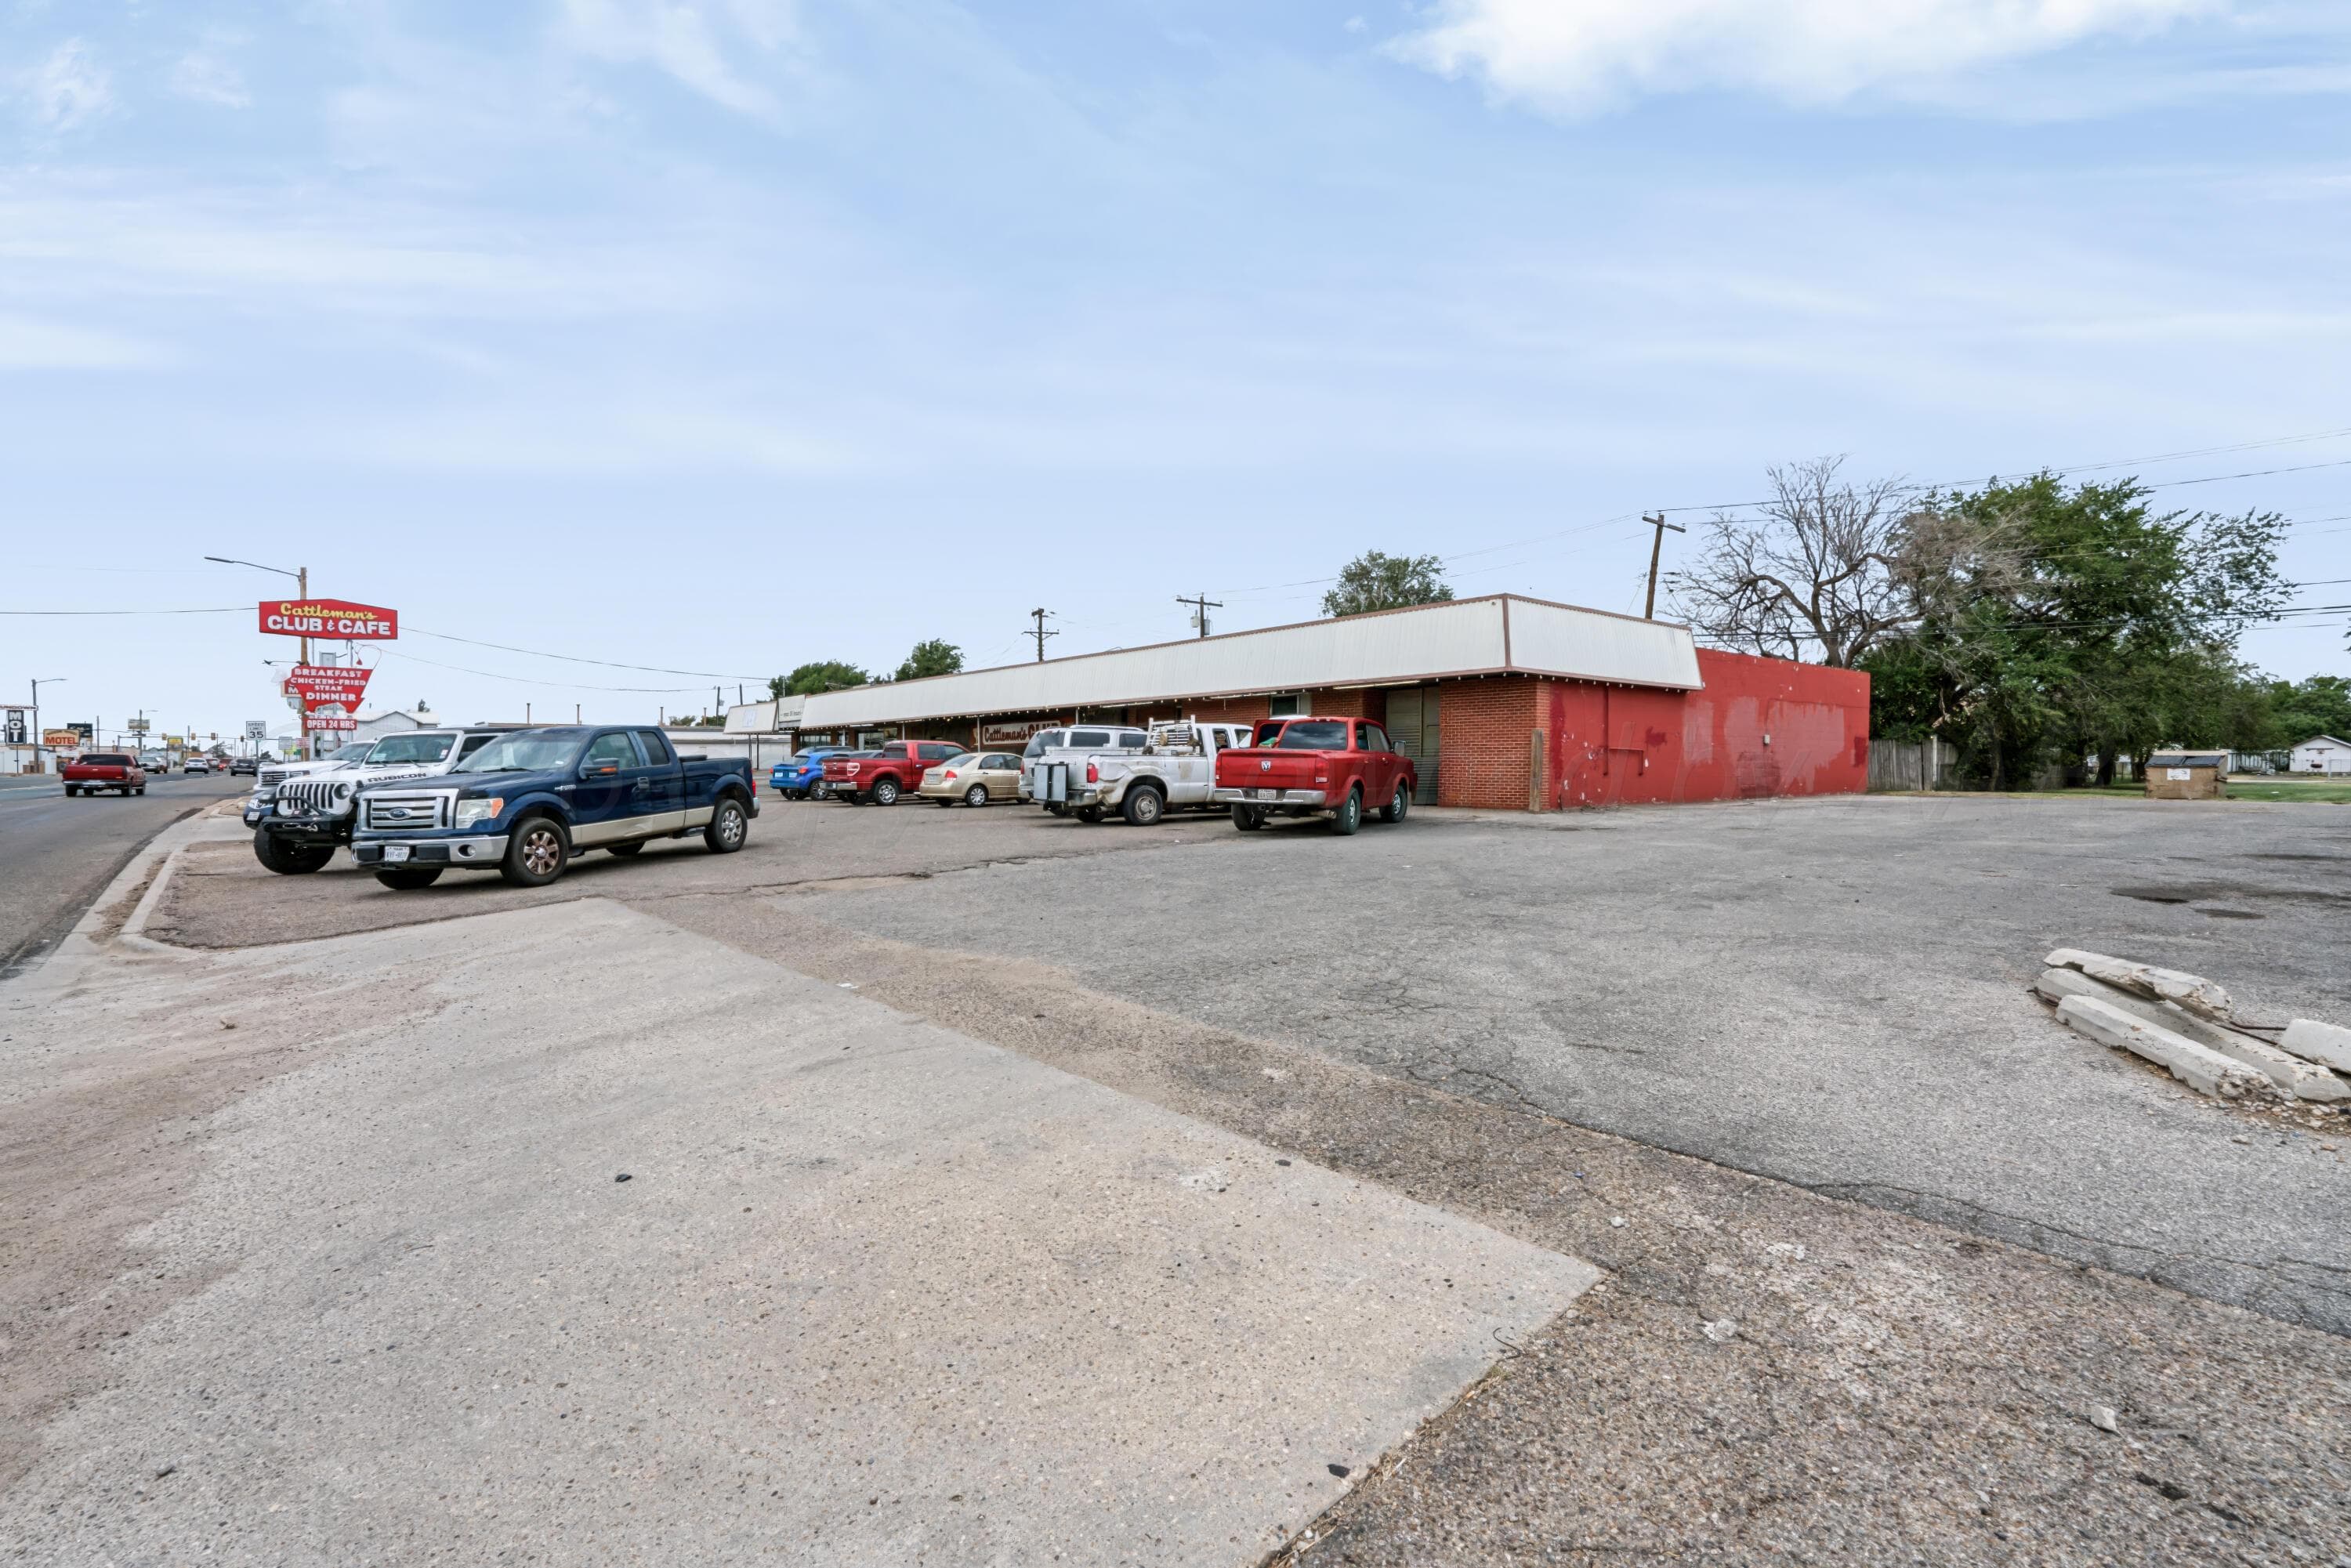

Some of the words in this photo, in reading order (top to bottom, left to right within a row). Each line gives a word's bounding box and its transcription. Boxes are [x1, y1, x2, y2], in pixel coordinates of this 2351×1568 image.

[281, 603, 379, 620] Cattleman's
[267, 615, 323, 632] CLUB
[327, 619, 335, 632] &
[338, 619, 391, 636] CAFE
[294, 668, 363, 678] BREAKFAST
[290, 677, 367, 686] CHICKEN-FRIED
[306, 692, 357, 701] DINNER
[306, 719, 327, 729] OPEN
[328, 719, 338, 729] 24
[339, 720, 355, 729] HRS
[984, 726, 1027, 742] Cattleman's
[368, 773, 427, 783] RUBICON
